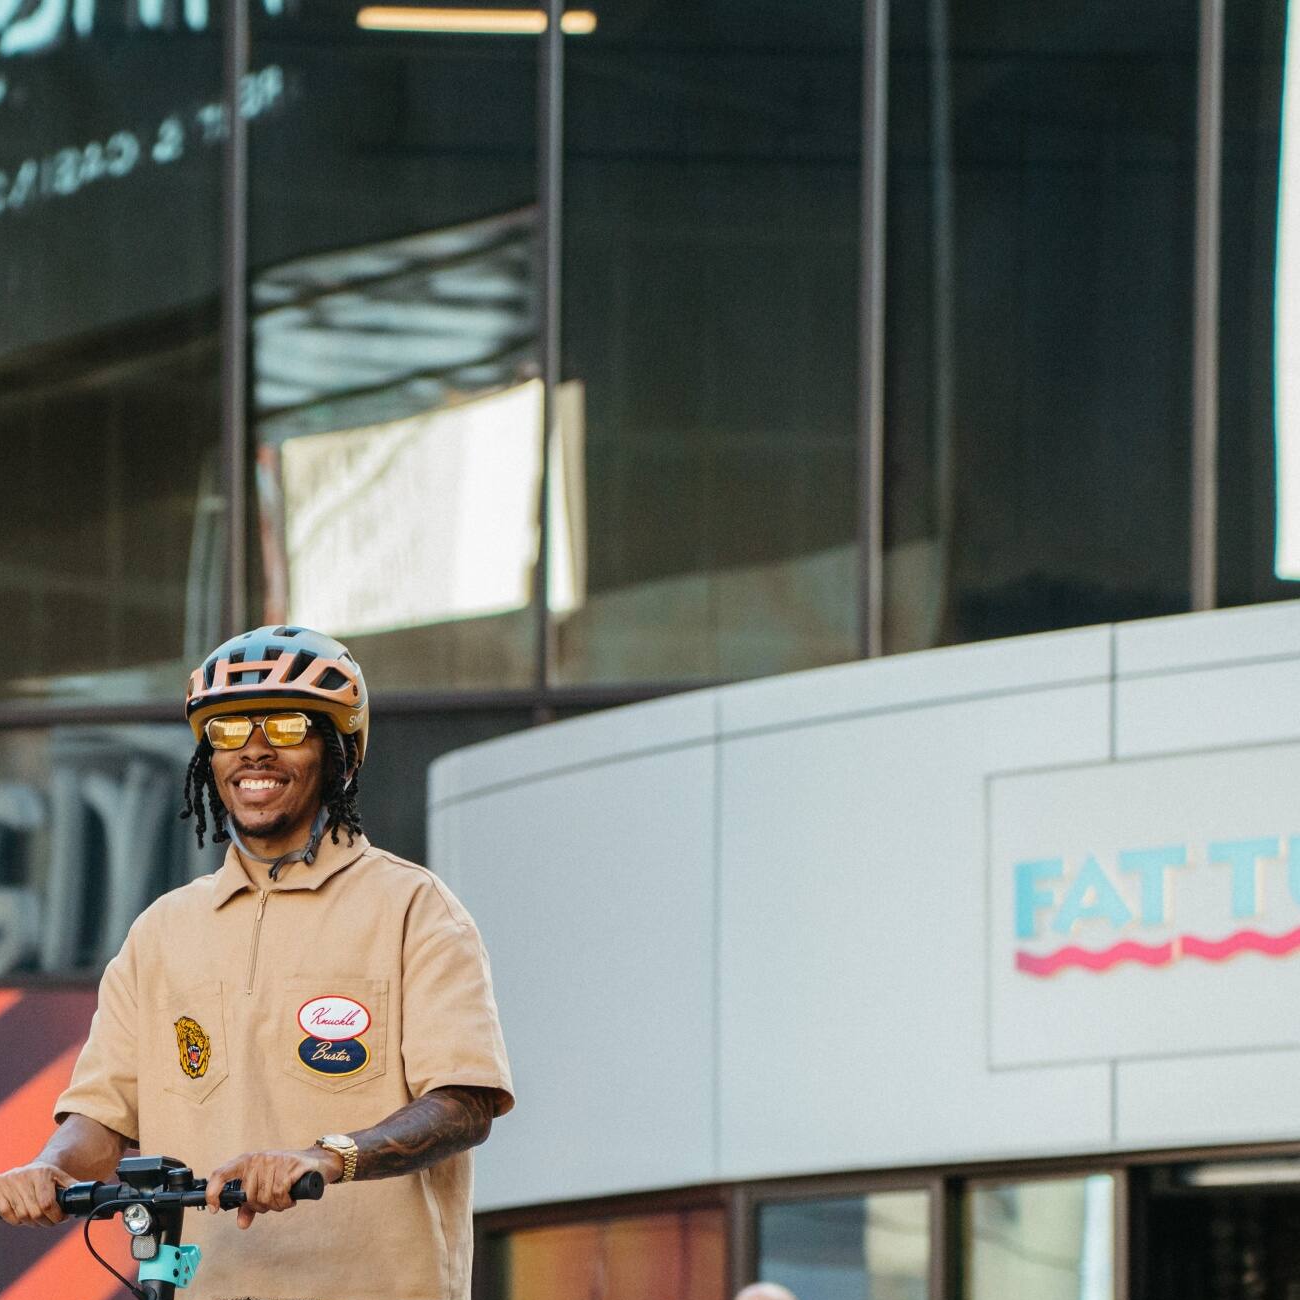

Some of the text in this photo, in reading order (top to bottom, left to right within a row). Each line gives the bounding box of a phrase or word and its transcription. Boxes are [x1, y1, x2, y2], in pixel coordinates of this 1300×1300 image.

[1014, 832, 1300, 942] FAT T
[310, 1006, 361, 1026] Knuckle
[310, 1040, 352, 1062] Buster
